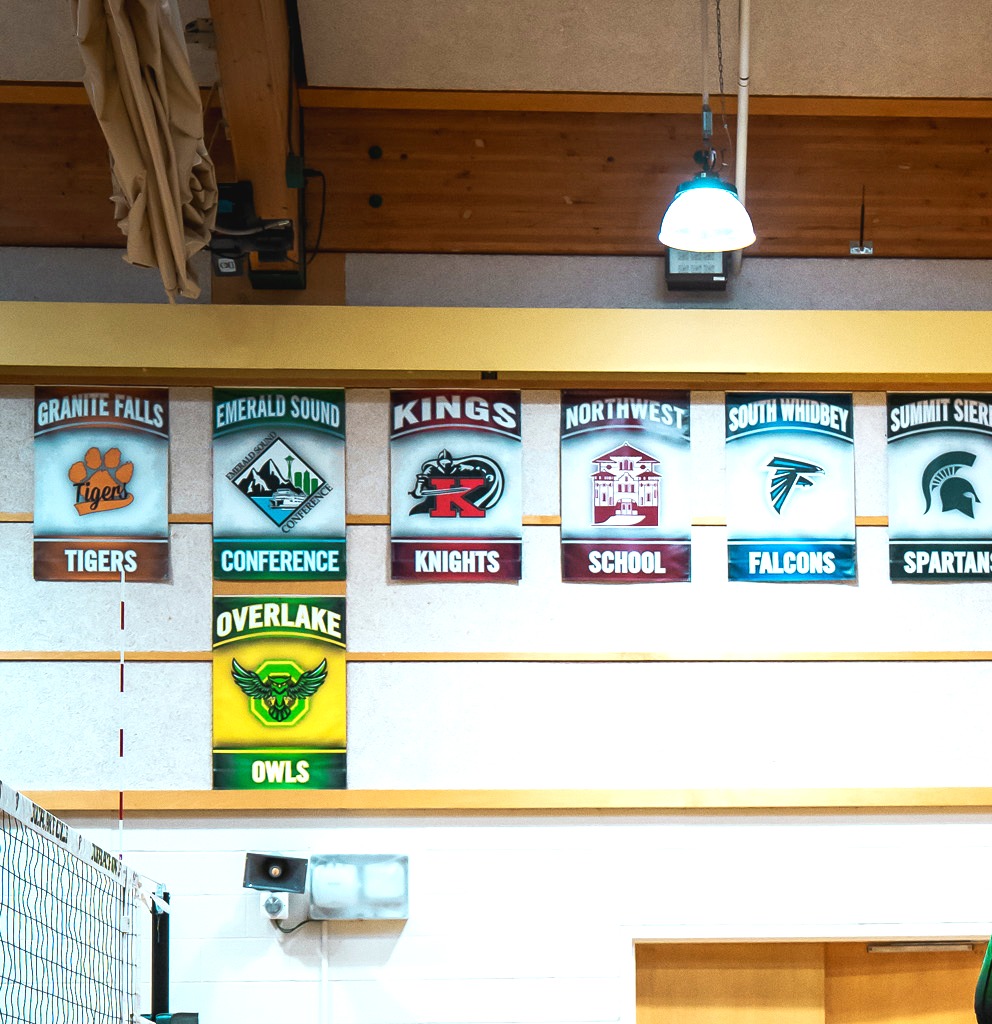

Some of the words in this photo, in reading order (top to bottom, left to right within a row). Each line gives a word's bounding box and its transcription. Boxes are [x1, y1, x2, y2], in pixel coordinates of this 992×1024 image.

[37, 393, 109, 428] GRANITE
[114, 393, 164, 429] FALLS
[216, 394, 286, 428] EMERALD
[290, 395, 340, 429] SOUND
[393, 396, 518, 430] KINGS
[565, 398, 686, 430] NORTHWEST
[728, 398, 777, 432] SOUTH
[780, 398, 849, 433] WHIDBEY
[890, 399, 948, 432] SUMMIT
[225, 451, 256, 481] EMERALD
[254, 431, 277, 455] SOUND
[73, 482, 128, 507] Tigers
[281, 483, 334, 534] CONFERENCE
[429, 477, 485, 518] K
[64, 550, 137, 572] TIGERS
[221, 550, 340, 572] CONFERENCE
[415, 550, 500, 573] KNIGHTS
[588, 551, 666, 574] SCHOOL
[748, 551, 836, 574] FALCONS
[216, 603, 342, 639] OVERLAKE
[251, 760, 310, 783] OWLS
